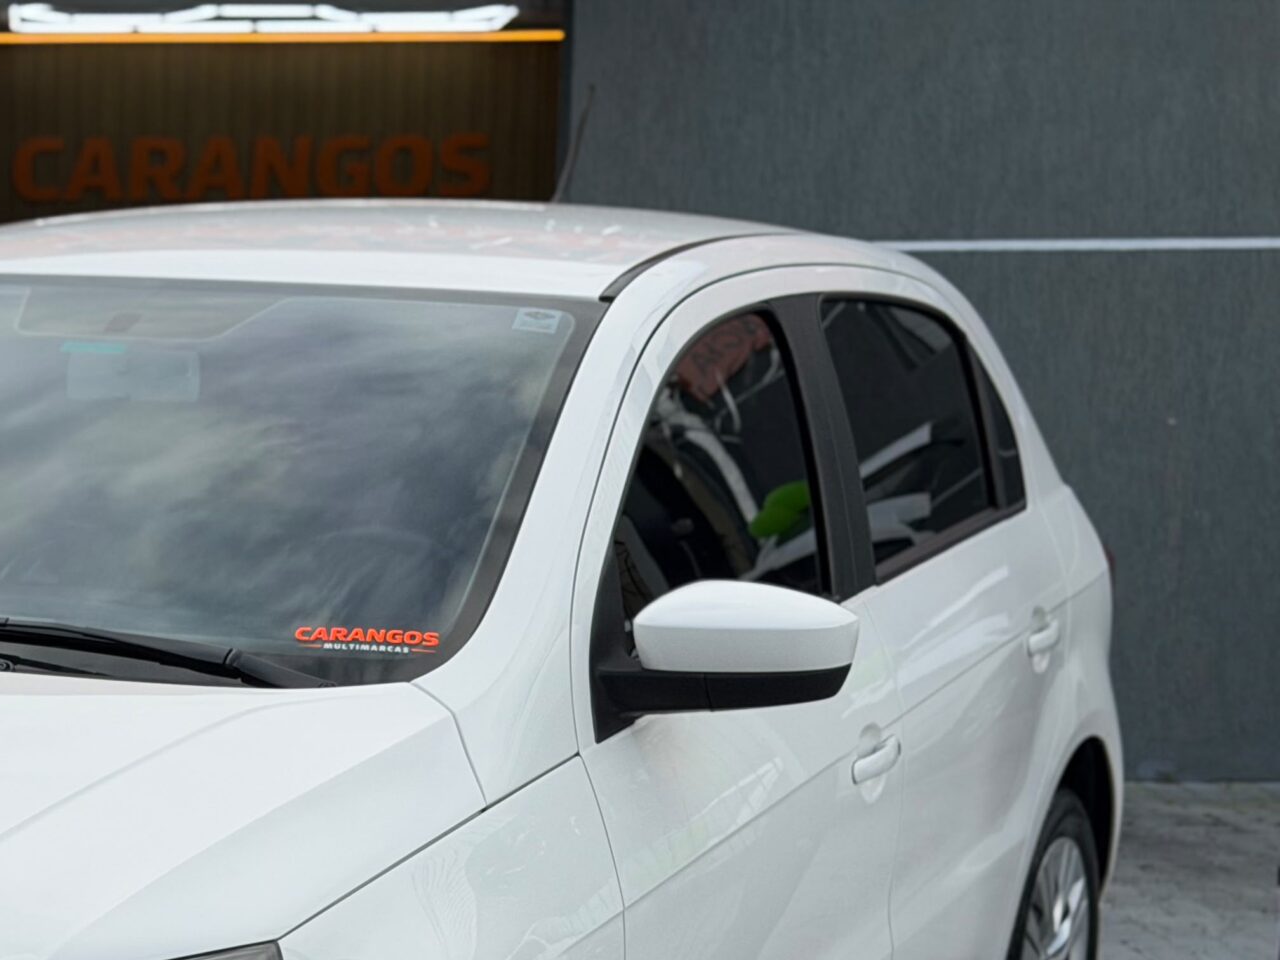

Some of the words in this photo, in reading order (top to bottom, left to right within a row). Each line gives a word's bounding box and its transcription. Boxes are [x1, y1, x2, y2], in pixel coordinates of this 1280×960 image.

[13, 134, 491, 201] CARANGOS
[295, 627, 440, 646] CARANGOS
[323, 643, 410, 653] MULTIMARCAS
